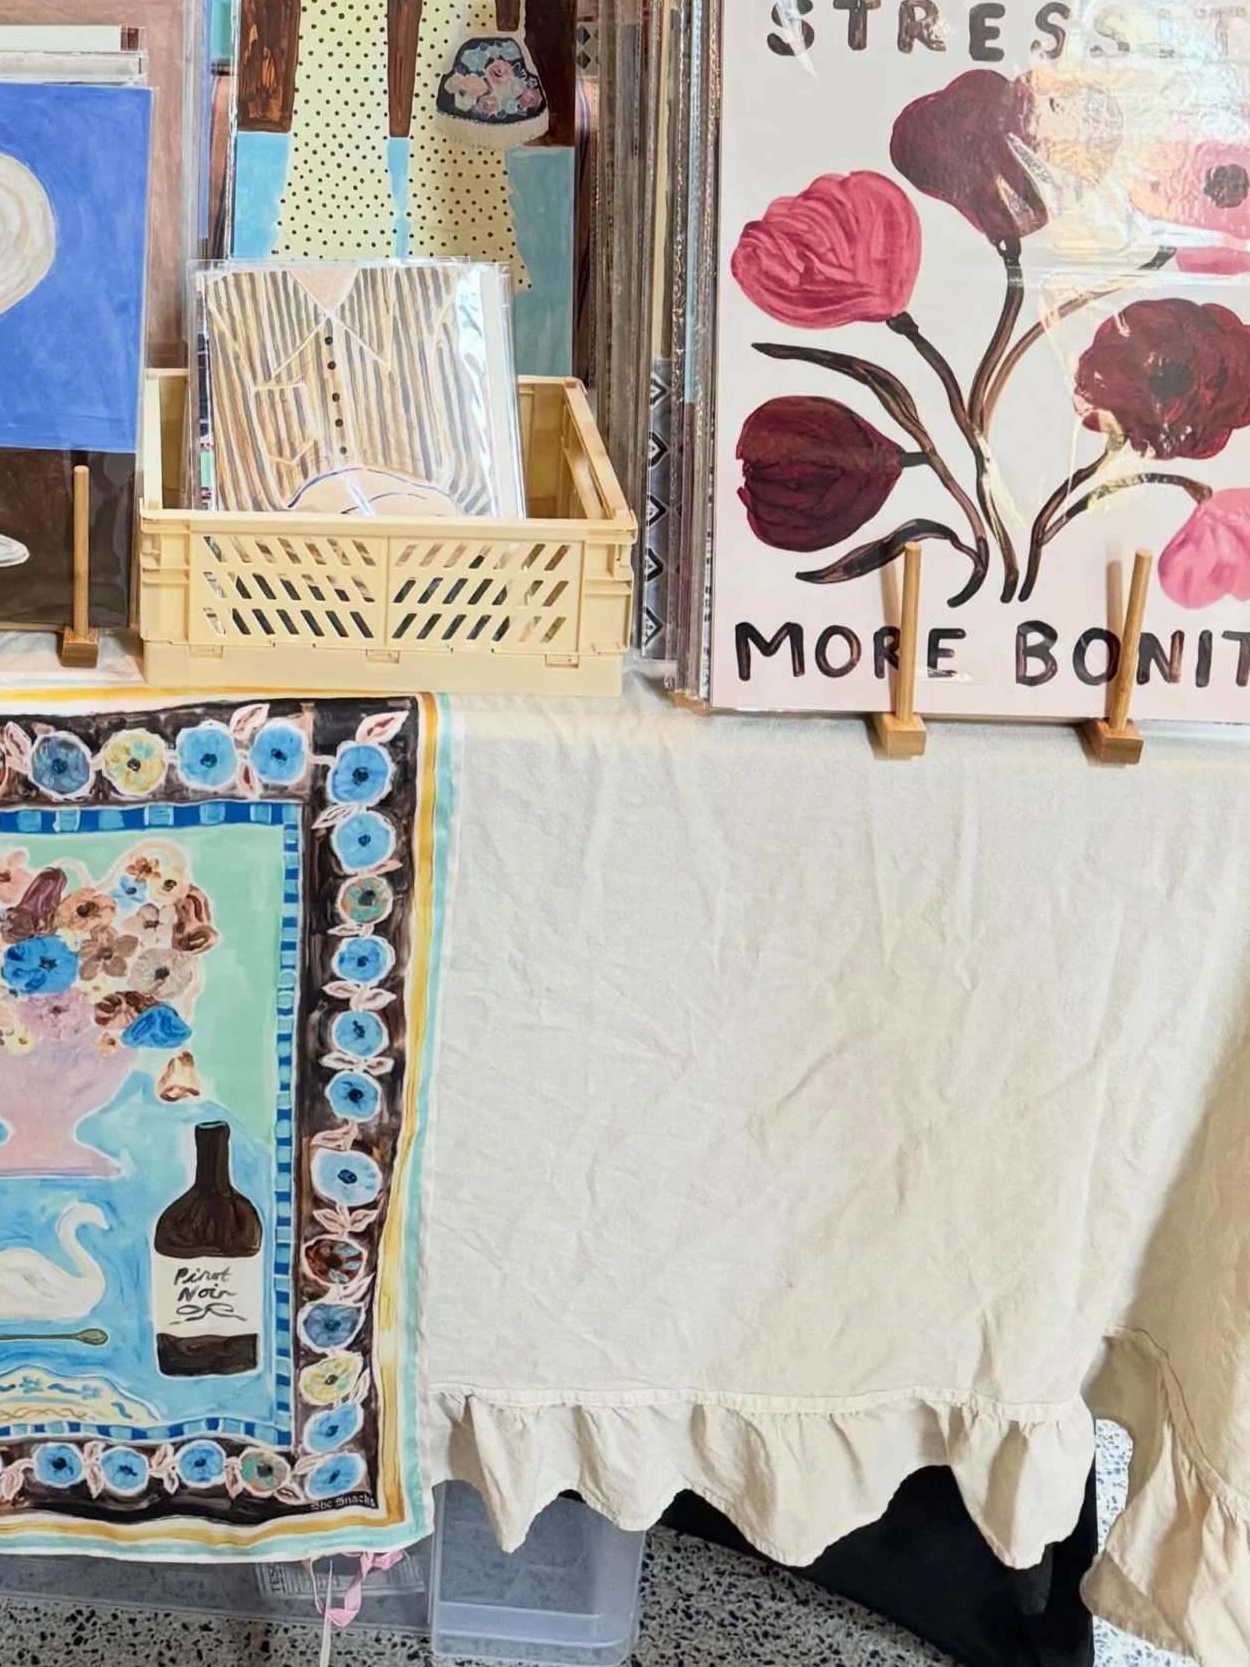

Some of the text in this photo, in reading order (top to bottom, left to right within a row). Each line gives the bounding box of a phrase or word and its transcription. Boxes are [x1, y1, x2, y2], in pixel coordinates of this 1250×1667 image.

[734, 619, 1250, 688] MORE BONIT
[173, 1267, 238, 1302] Pinot Noir
